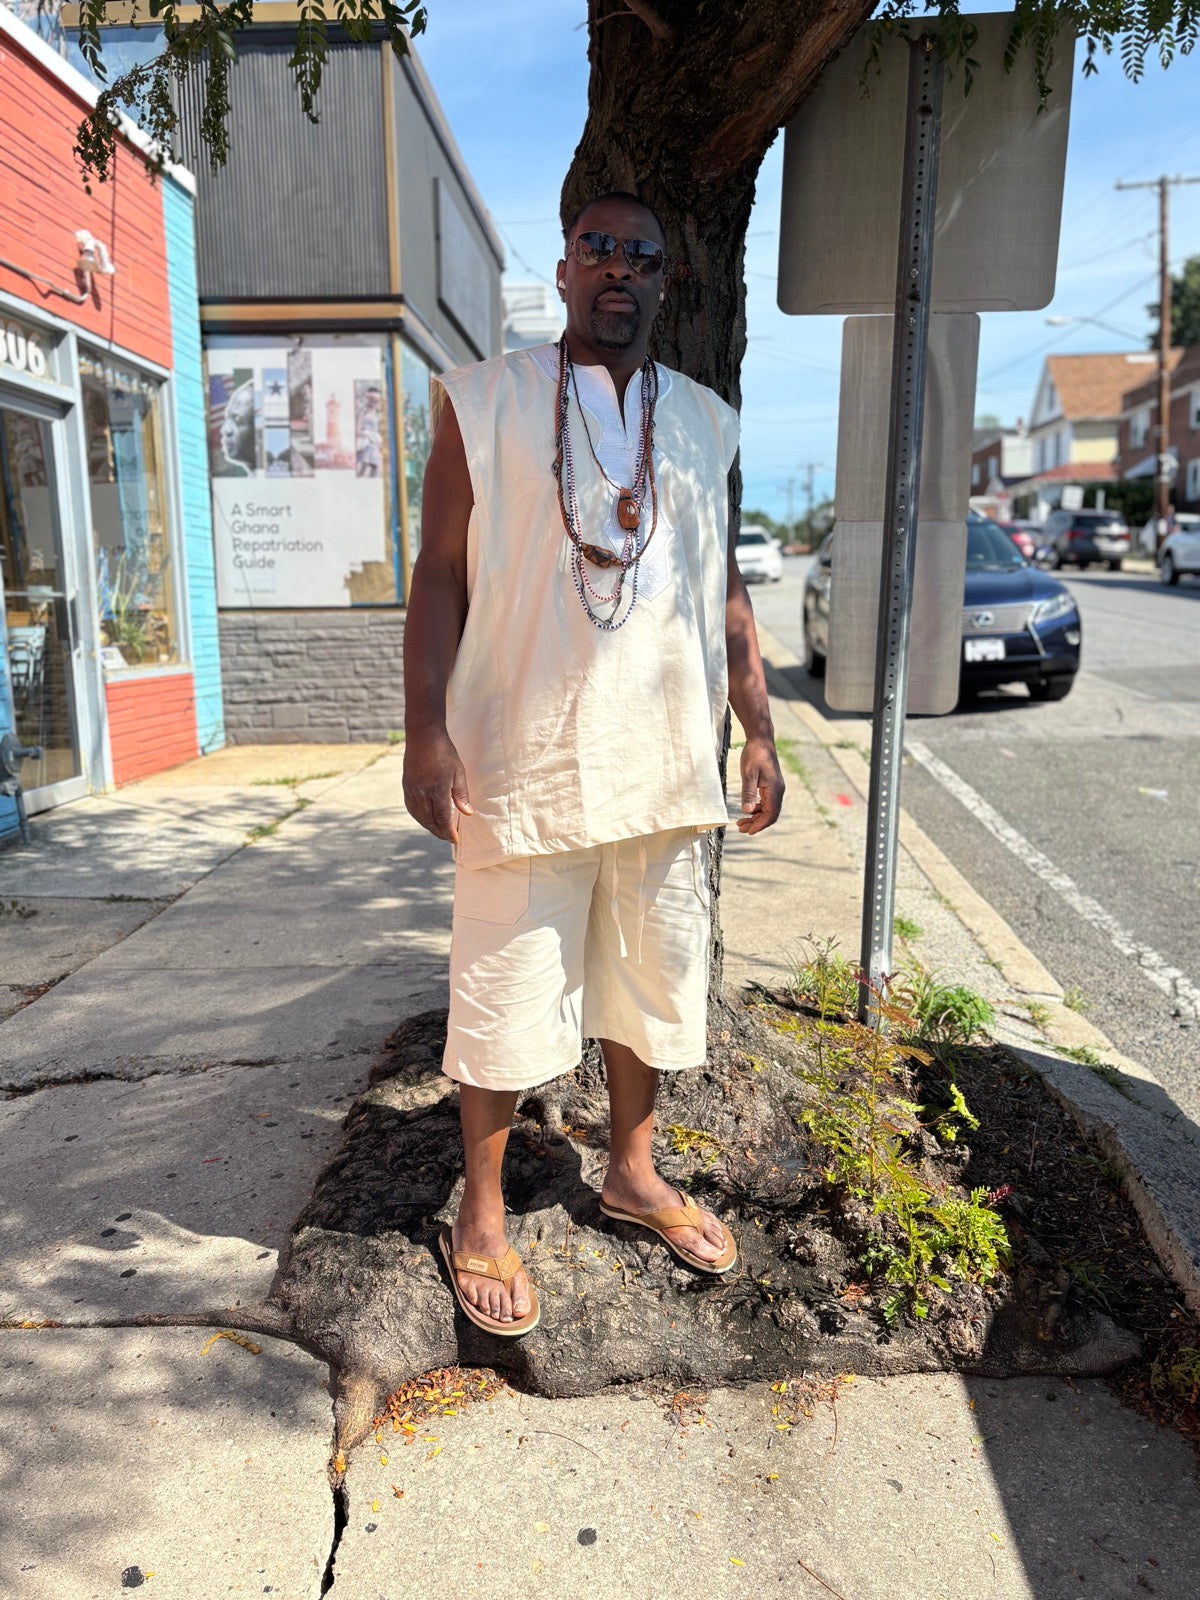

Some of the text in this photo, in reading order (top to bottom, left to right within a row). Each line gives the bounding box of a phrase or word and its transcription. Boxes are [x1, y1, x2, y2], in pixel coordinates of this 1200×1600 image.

[231, 503, 293, 517] A Smart
[231, 520, 280, 534] Ghana
[232, 538, 324, 555] Repatriation
[232, 554, 276, 569] Guide
